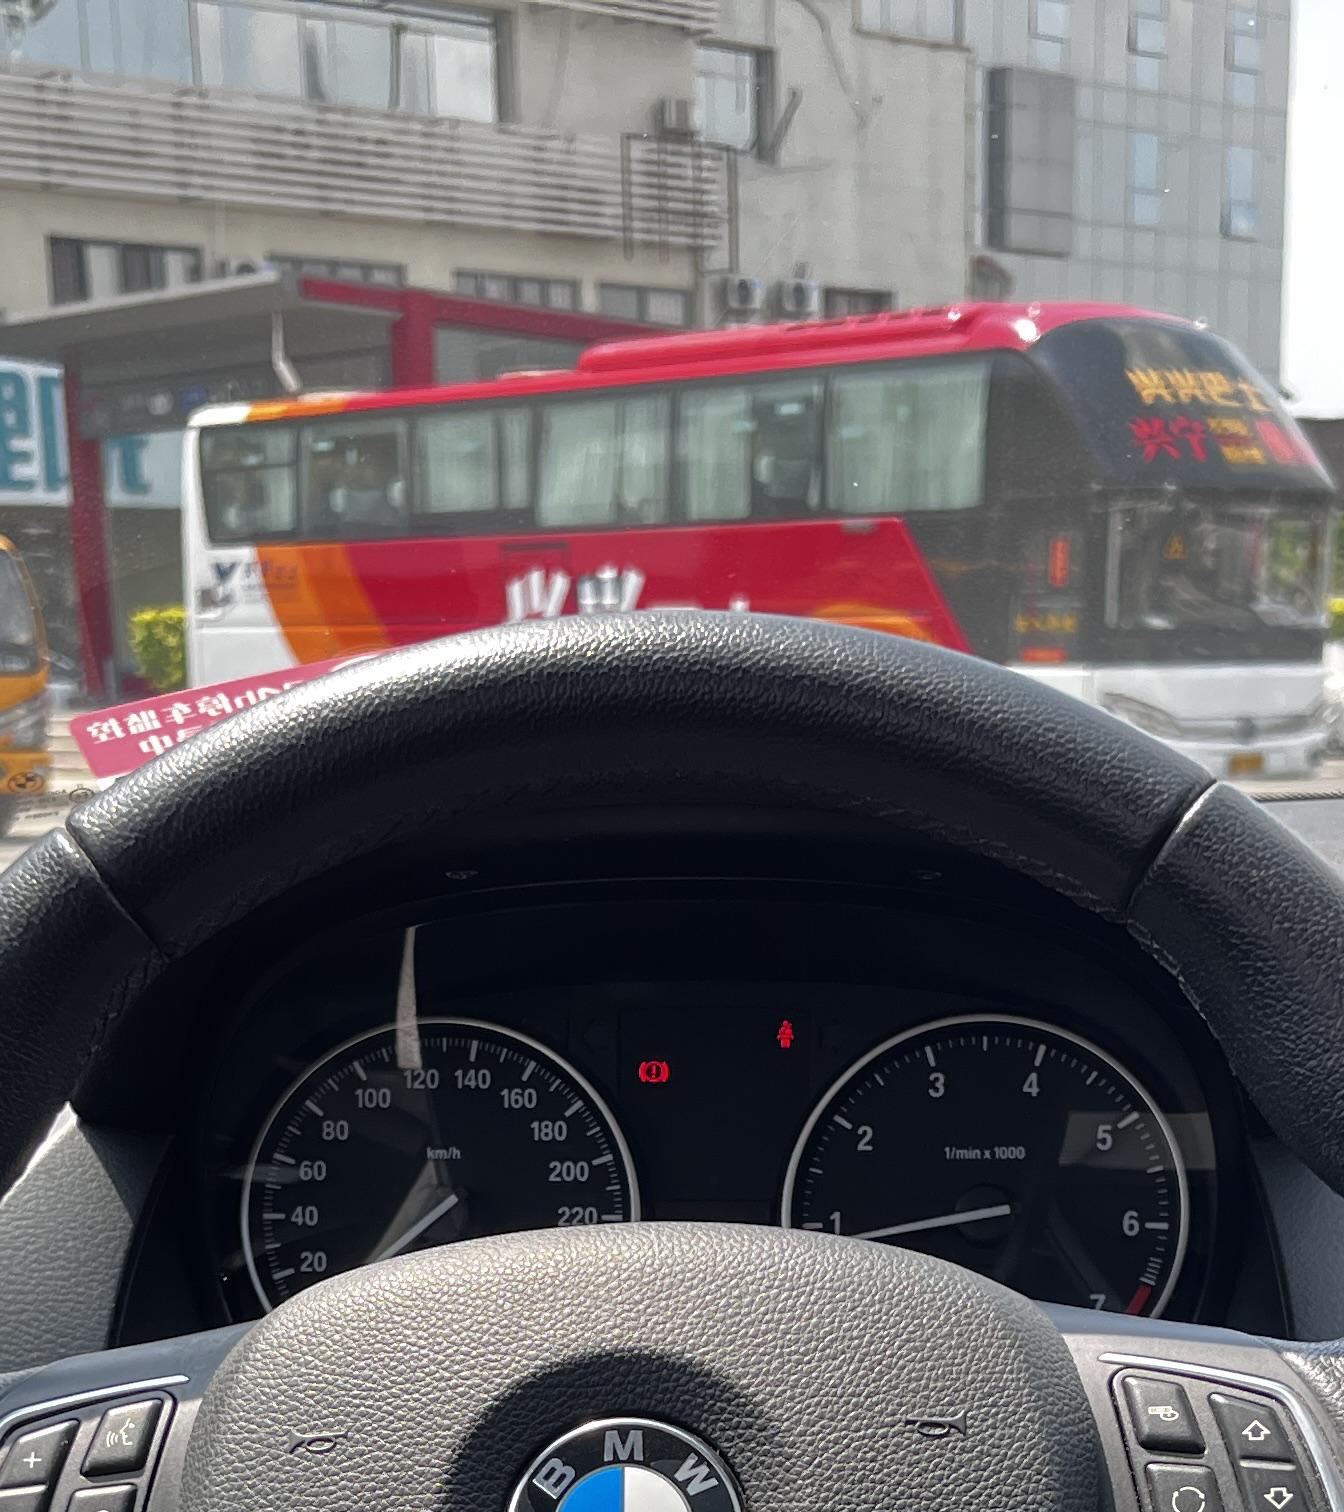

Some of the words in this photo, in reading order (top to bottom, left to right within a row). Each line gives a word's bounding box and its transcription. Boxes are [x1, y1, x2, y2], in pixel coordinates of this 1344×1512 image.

[403, 1070, 439, 1089] 120
[455, 1070, 491, 1089] 140
[928, 1073, 945, 1098] 3
[1022, 1073, 1039, 1097] 4
[355, 1089, 391, 1109] 100
[501, 1089, 537, 1109] 160
[322, 1122, 349, 1141] 80
[530, 1121, 567, 1141] 180
[857, 1126, 873, 1151] 2
[1096, 1125, 1112, 1150] 5
[426, 1147, 461, 1160] km/h
[944, 1146, 981, 1160] 1/min
[993, 1146, 1026, 1160] 1000
[299, 1161, 326, 1181] 60
[548, 1162, 589, 1182] 200
[290, 1207, 318, 1226] 40
[557, 1207, 597, 1226] 220
[829, 1211, 841, 1234] 1
[1122, 1211, 1140, 1236] 6
[300, 1252, 327, 1272] 20
[533, 1430, 719, 1499] BMW
